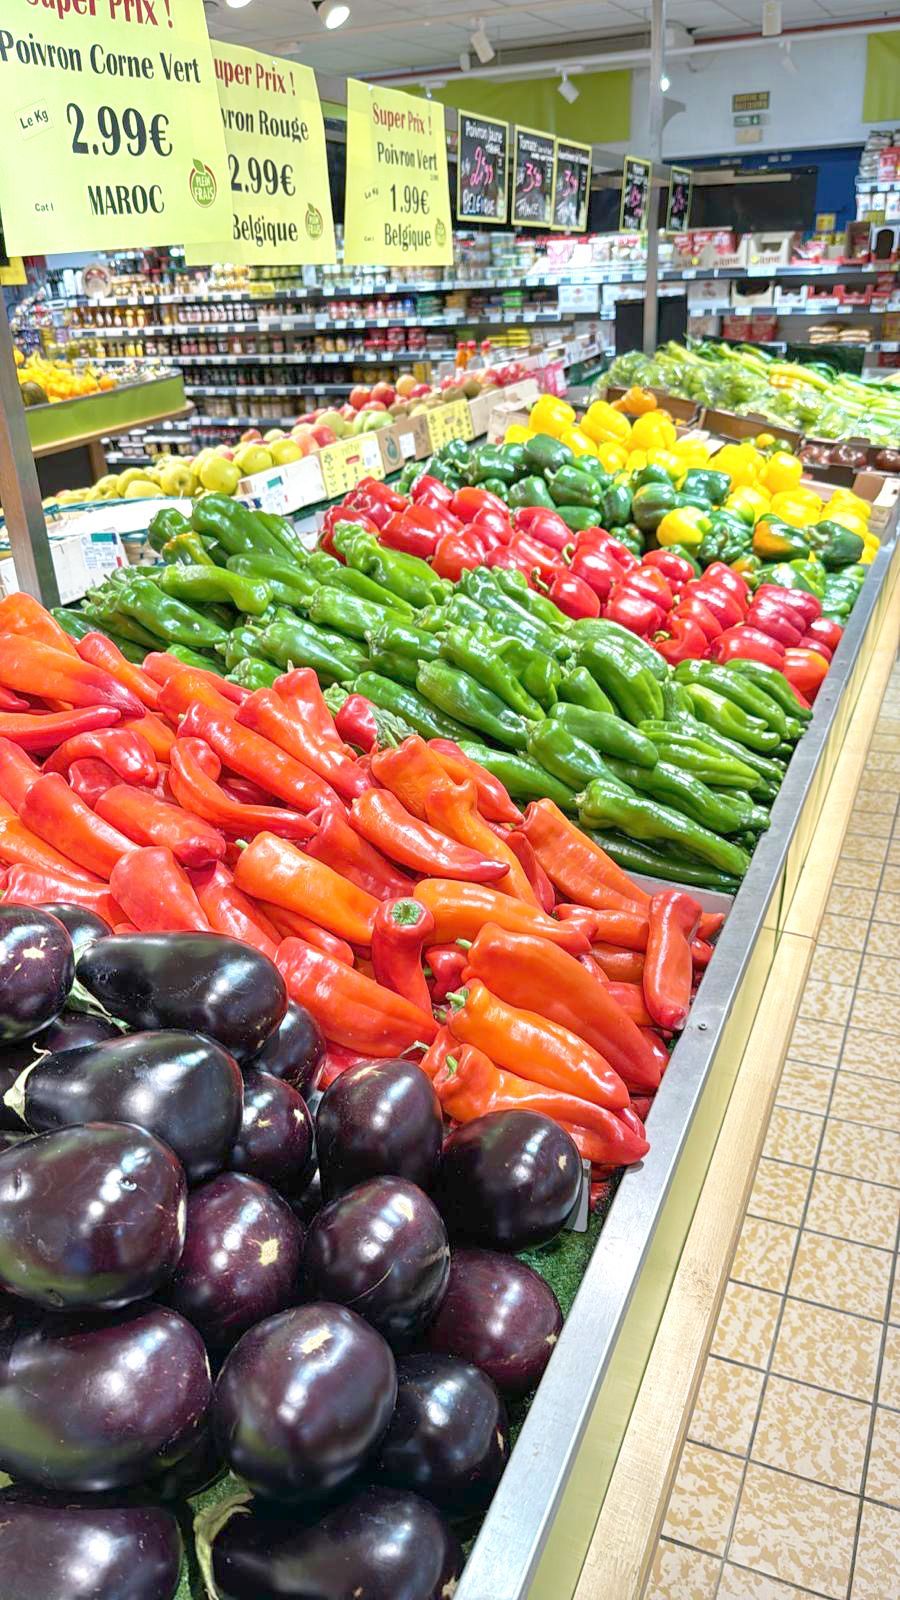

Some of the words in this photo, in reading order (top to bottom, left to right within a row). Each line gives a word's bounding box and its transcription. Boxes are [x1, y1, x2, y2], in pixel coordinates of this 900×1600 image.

[0, 29, 82, 72] Poivron
[90, 44, 154, 79] Corne
[160, 52, 201, 83] Vert
[214, 58, 252, 88] uper
[256, 63, 286, 94] Prix
[289, 71, 296, 96] !
[20, 114, 33, 129] Le
[34, 108, 49, 123] Kg
[66, 102, 173, 157] 2.99€
[258, 109, 309, 143] Rouge
[372, 102, 405, 131] Super
[408, 110, 425, 135] Prix
[428, 116, 432, 136] !
[377, 141, 416, 168] Poivron
[417, 149, 438, 171] Vert
[228, 154, 296, 196] 2.99€
[35, 202, 49, 212] Cat
[87, 184, 165, 215] MAROC
[193, 186, 215, 201] FRAIS
[390, 184, 430, 215] 1.99€
[233, 213, 298, 247] Belgique
[384, 223, 431, 252] Belgique
